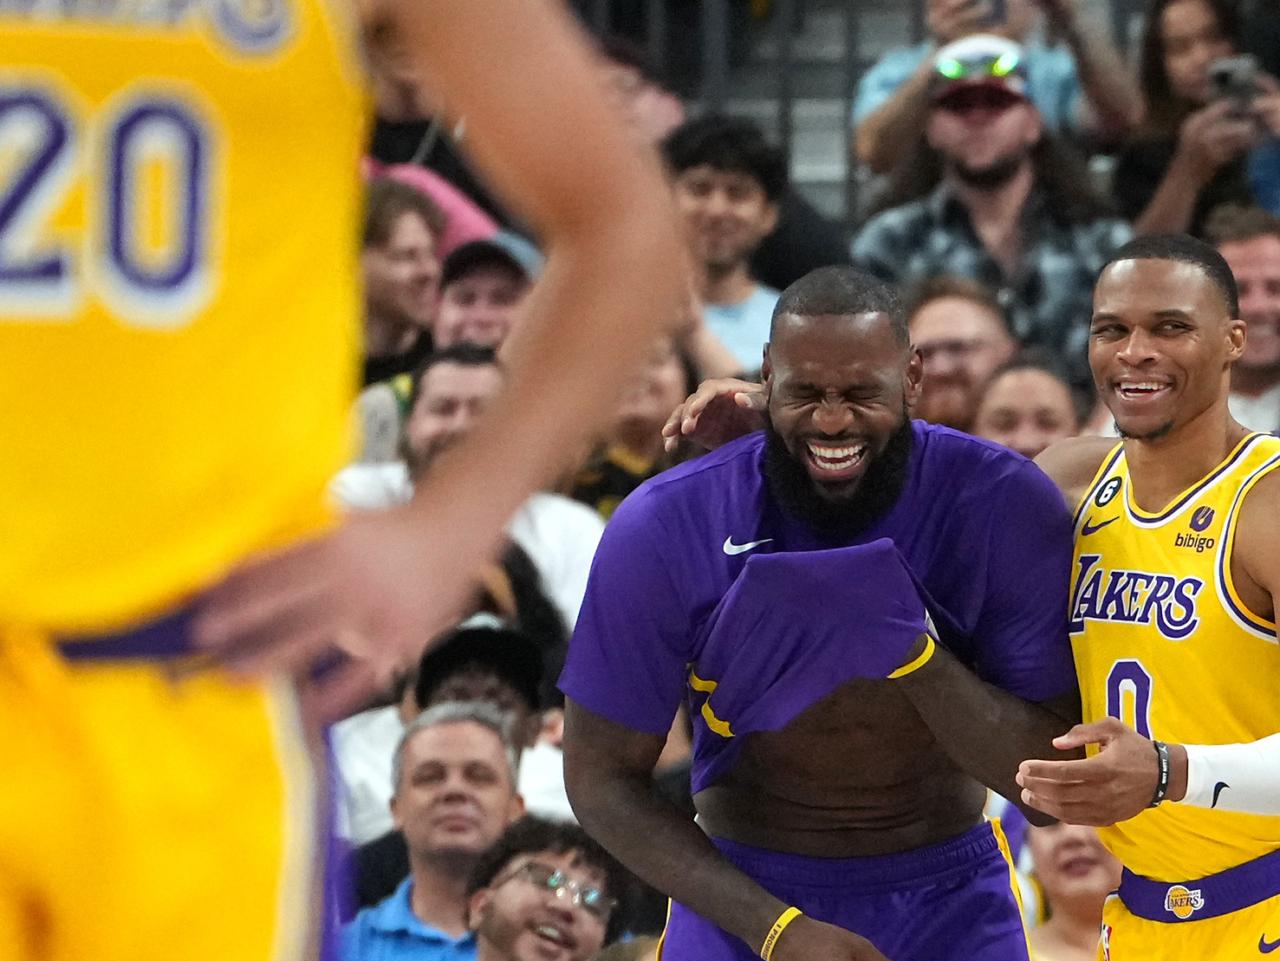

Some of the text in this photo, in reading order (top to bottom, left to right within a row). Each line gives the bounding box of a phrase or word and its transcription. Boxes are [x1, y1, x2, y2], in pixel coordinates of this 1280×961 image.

[0, 82, 218, 312] 20
[1098, 479, 1116, 503] 6
[1175, 533, 1215, 553] bibigo
[1068, 554, 1205, 640] LAKERS
[1106, 659, 1152, 740] 0
